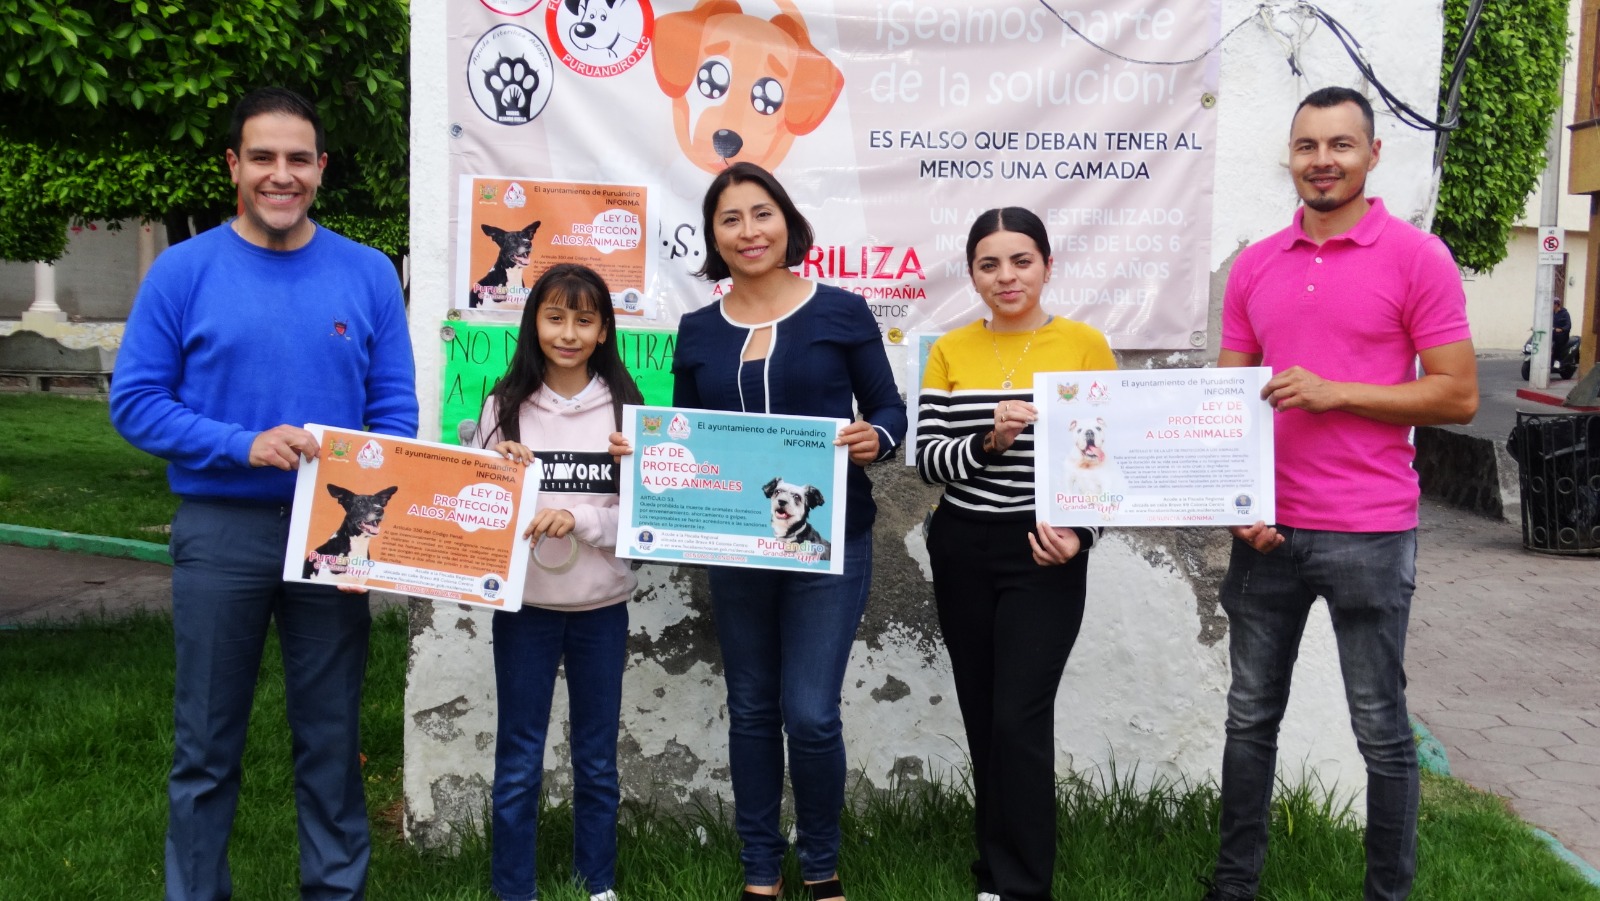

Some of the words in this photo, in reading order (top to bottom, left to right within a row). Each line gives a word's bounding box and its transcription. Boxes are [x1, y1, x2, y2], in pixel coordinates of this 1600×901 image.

[1060, 6, 1176, 48] parte
[871, 63, 922, 103] de
[939, 66, 970, 107] la
[986, 62, 1177, 107] solución!
[869, 131, 893, 149] ES
[900, 131, 968, 150] FALSO
[974, 131, 1019, 151] QUE
[1025, 132, 1097, 151] DEBAN
[1105, 132, 1168, 151] TENER
[1174, 132, 1203, 151] AL
[920, 160, 994, 179] MENOS
[1001, 161, 1047, 180] UNA
[1055, 161, 1150, 180] CAMADA
[542, 187, 590, 197] ayuntamiento
[602, 190, 640, 198] Puruándiro
[603, 214, 620, 223] LEY
[624, 215, 638, 224] DE
[930, 208, 957, 225] UN
[572, 223, 637, 236] PROTECCIÓN
[552, 236, 560, 244] A
[563, 236, 583, 246] LOS
[585, 236, 638, 248] ANIMALES
[1094, 235, 1113, 252] DE
[1126, 235, 1160, 252] LOS
[1169, 235, 1181, 252] 6
[1065, 256, 1108, 279] MÁS
[1112, 258, 1170, 280] AÑOS
[450, 329, 491, 365] NO
[446, 373, 464, 405] A
[1131, 379, 1186, 388] ayuntamiento
[1201, 377, 1244, 386] Puruándiro
[1202, 402, 1224, 411] LEY
[1228, 402, 1242, 410] DE
[1168, 414, 1242, 426] PROTECCIÓN
[698, 422, 706, 430] El
[708, 424, 764, 434] ayuntamiento
[766, 426, 778, 434] de
[780, 427, 826, 438] Puruándiro
[1146, 430, 1154, 439] A
[1158, 430, 1180, 439] LOS
[1184, 429, 1242, 438] ANIMALES
[783, 439, 826, 448] INFORMA
[395, 446, 402, 454] El
[404, 448, 459, 464] ayuntamiento
[461, 458, 472, 466] de
[474, 460, 518, 473] Puruándiro
[644, 446, 664, 456] LEY
[669, 448, 684, 458] DE
[565, 463, 612, 480] YORK
[642, 460, 720, 474] PROTECCIÓN
[476, 471, 516, 484] INFORMA
[642, 476, 651, 485] A
[656, 476, 678, 486] LOS
[682, 478, 742, 491] ANIMALES
[471, 487, 492, 498] LEY
[495, 491, 512, 502] DE
[434, 494, 509, 515] PROTECCIÓN
[409, 505, 420, 514] A
[420, 507, 444, 518] LOS
[448, 512, 506, 529] ANIMALES
